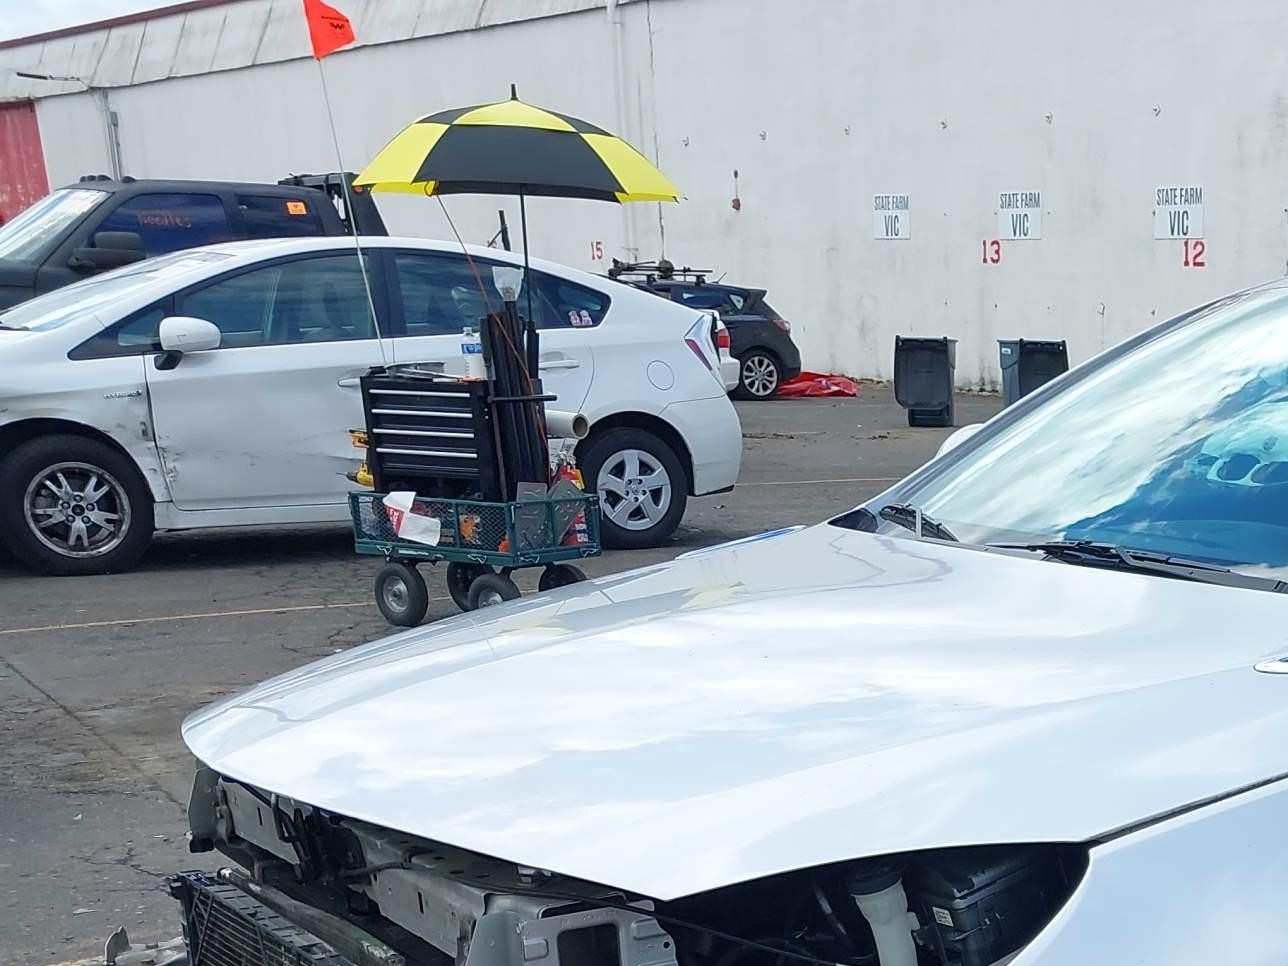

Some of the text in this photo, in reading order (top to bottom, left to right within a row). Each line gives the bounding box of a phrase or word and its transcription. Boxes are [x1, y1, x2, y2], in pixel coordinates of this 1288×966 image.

[874, 195, 909, 211] STATE FARM
[999, 192, 1041, 209] STATE FARM
[1156, 187, 1203, 206] STATE FARM
[884, 215, 900, 237] VIC
[1011, 213, 1030, 237] VIC
[1168, 210, 1190, 236] VIC
[590, 241, 604, 261] 15
[982, 239, 1001, 264] 13
[1183, 240, 1206, 267] 12
